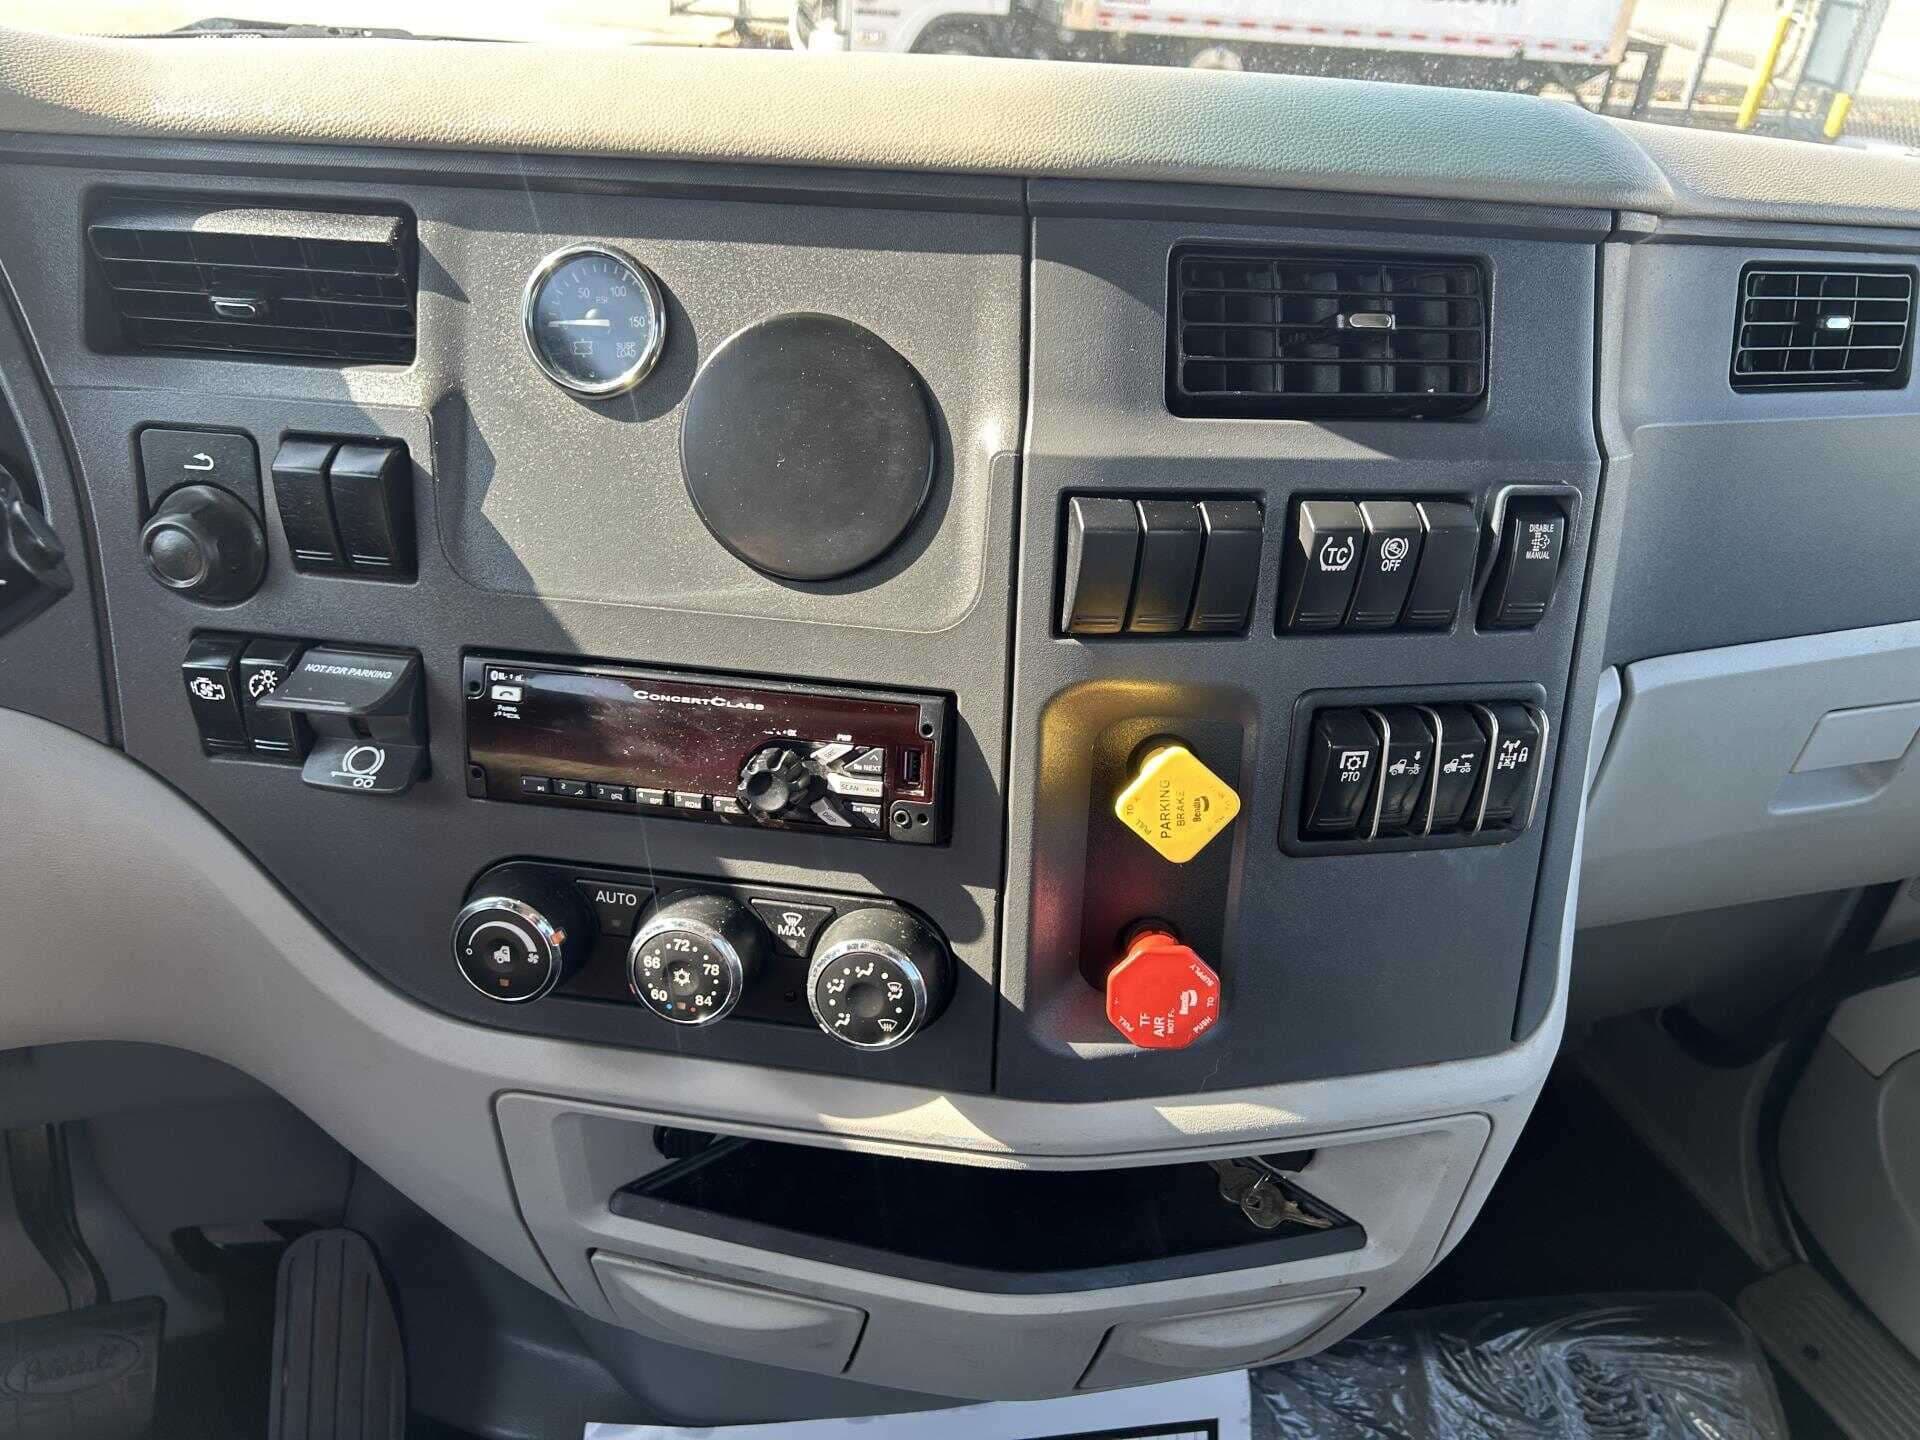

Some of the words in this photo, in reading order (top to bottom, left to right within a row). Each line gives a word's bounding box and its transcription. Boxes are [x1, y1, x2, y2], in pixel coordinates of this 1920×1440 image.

[577, 287, 590, 298] 50
[609, 285, 627, 297] 100
[629, 315, 646, 328] 150
[1529, 523, 1554, 533] DISABLE
[1327, 547, 1348, 564] TC
[1525, 551, 1550, 560] MANUAL
[1381, 559, 1402, 572] OFF
[304, 663, 327, 673] NOT
[326, 665, 348, 675] FOR
[347, 668, 393, 679] PARKING
[863, 764, 881, 772] NEXT
[1340, 771, 1361, 782] PTO
[861, 806, 880, 815] PREV
[1160, 779, 1171, 839] PARKING
[1176, 789, 1186, 827] BRAKE
[595, 890, 637, 906] AUTO
[777, 925, 806, 938] MAX
[673, 938, 690, 952] 72
[643, 955, 661, 969] 66
[703, 963, 720, 976] 78
[650, 988, 668, 1002] 60
[694, 994, 713, 1007] 84
[1206, 996, 1214, 1008] TO
[1153, 1016, 1165, 1037] AIR
[1167, 1019, 1175, 1034] NOT
